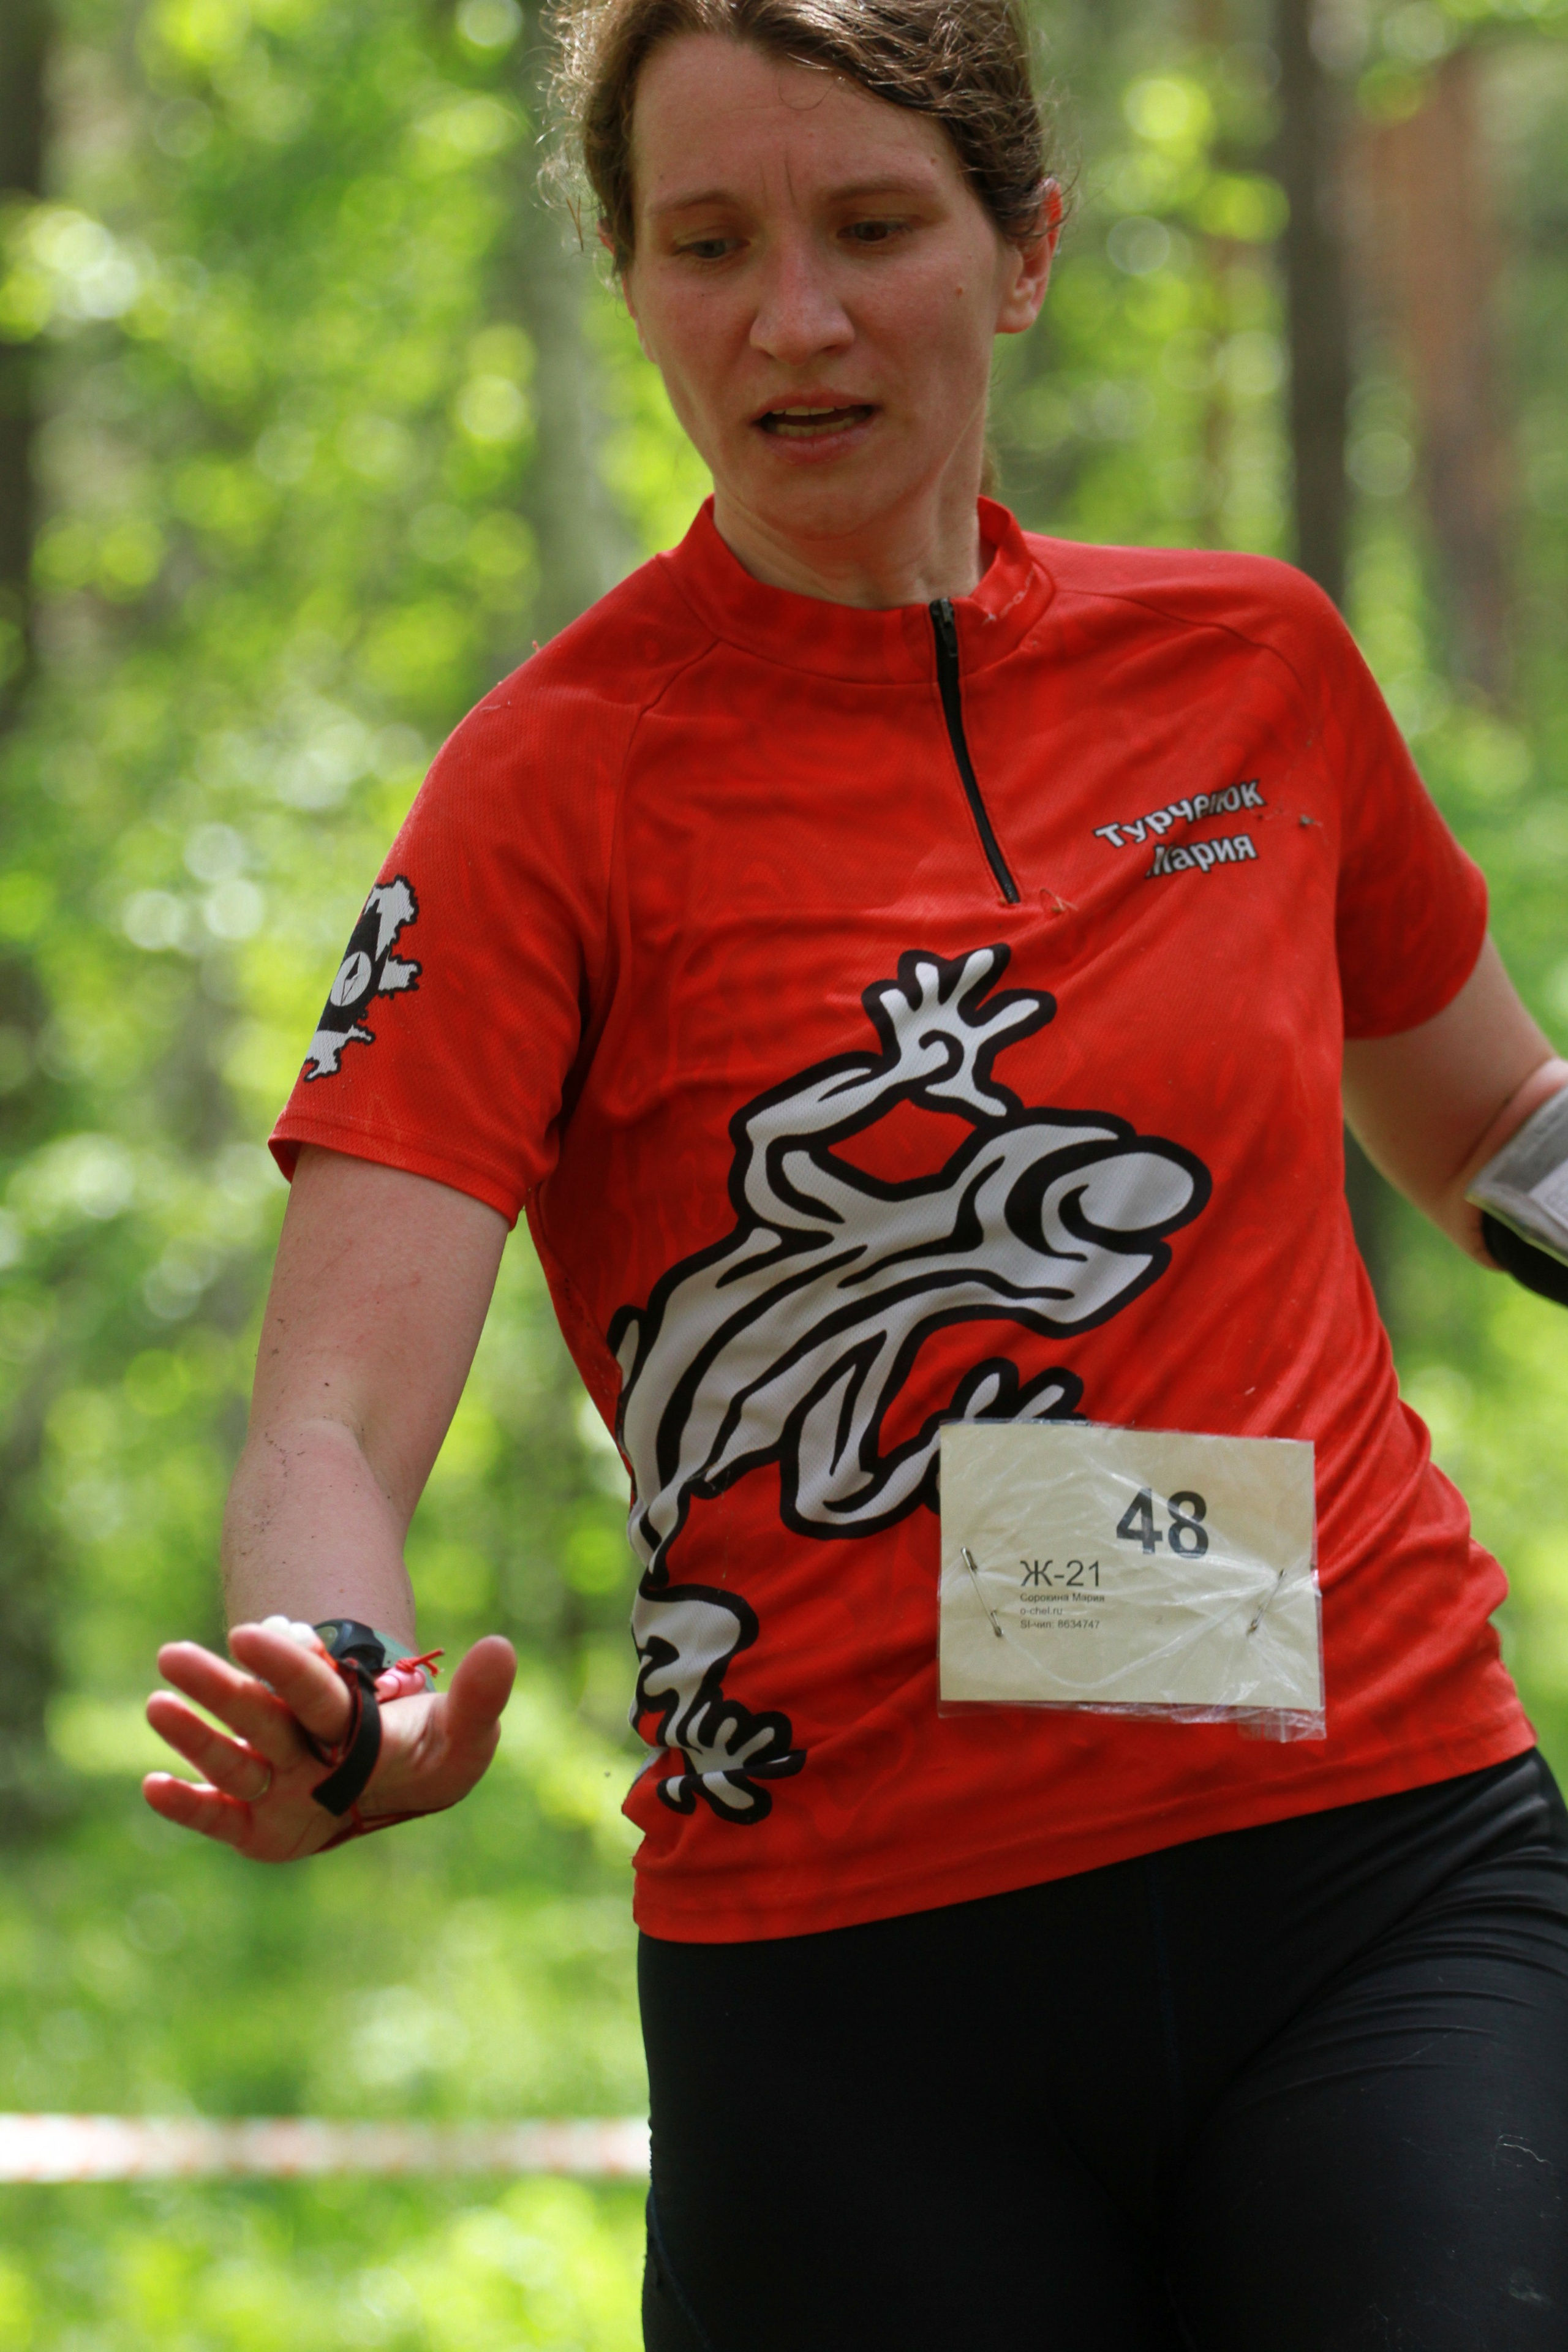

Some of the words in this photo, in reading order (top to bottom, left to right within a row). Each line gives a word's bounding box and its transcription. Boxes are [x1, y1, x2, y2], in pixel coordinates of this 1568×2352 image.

[1116, 1487, 1209, 1559] 48
[1020, 1560, 1099, 1586] Ж-21
[1020, 1593, 1069, 1603] Сорокина
[1072, 1593, 1104, 1603] Мария
[1020, 1607, 1063, 1615] o-chel.ru
[1057, 1619, 1100, 1629] 8634747
